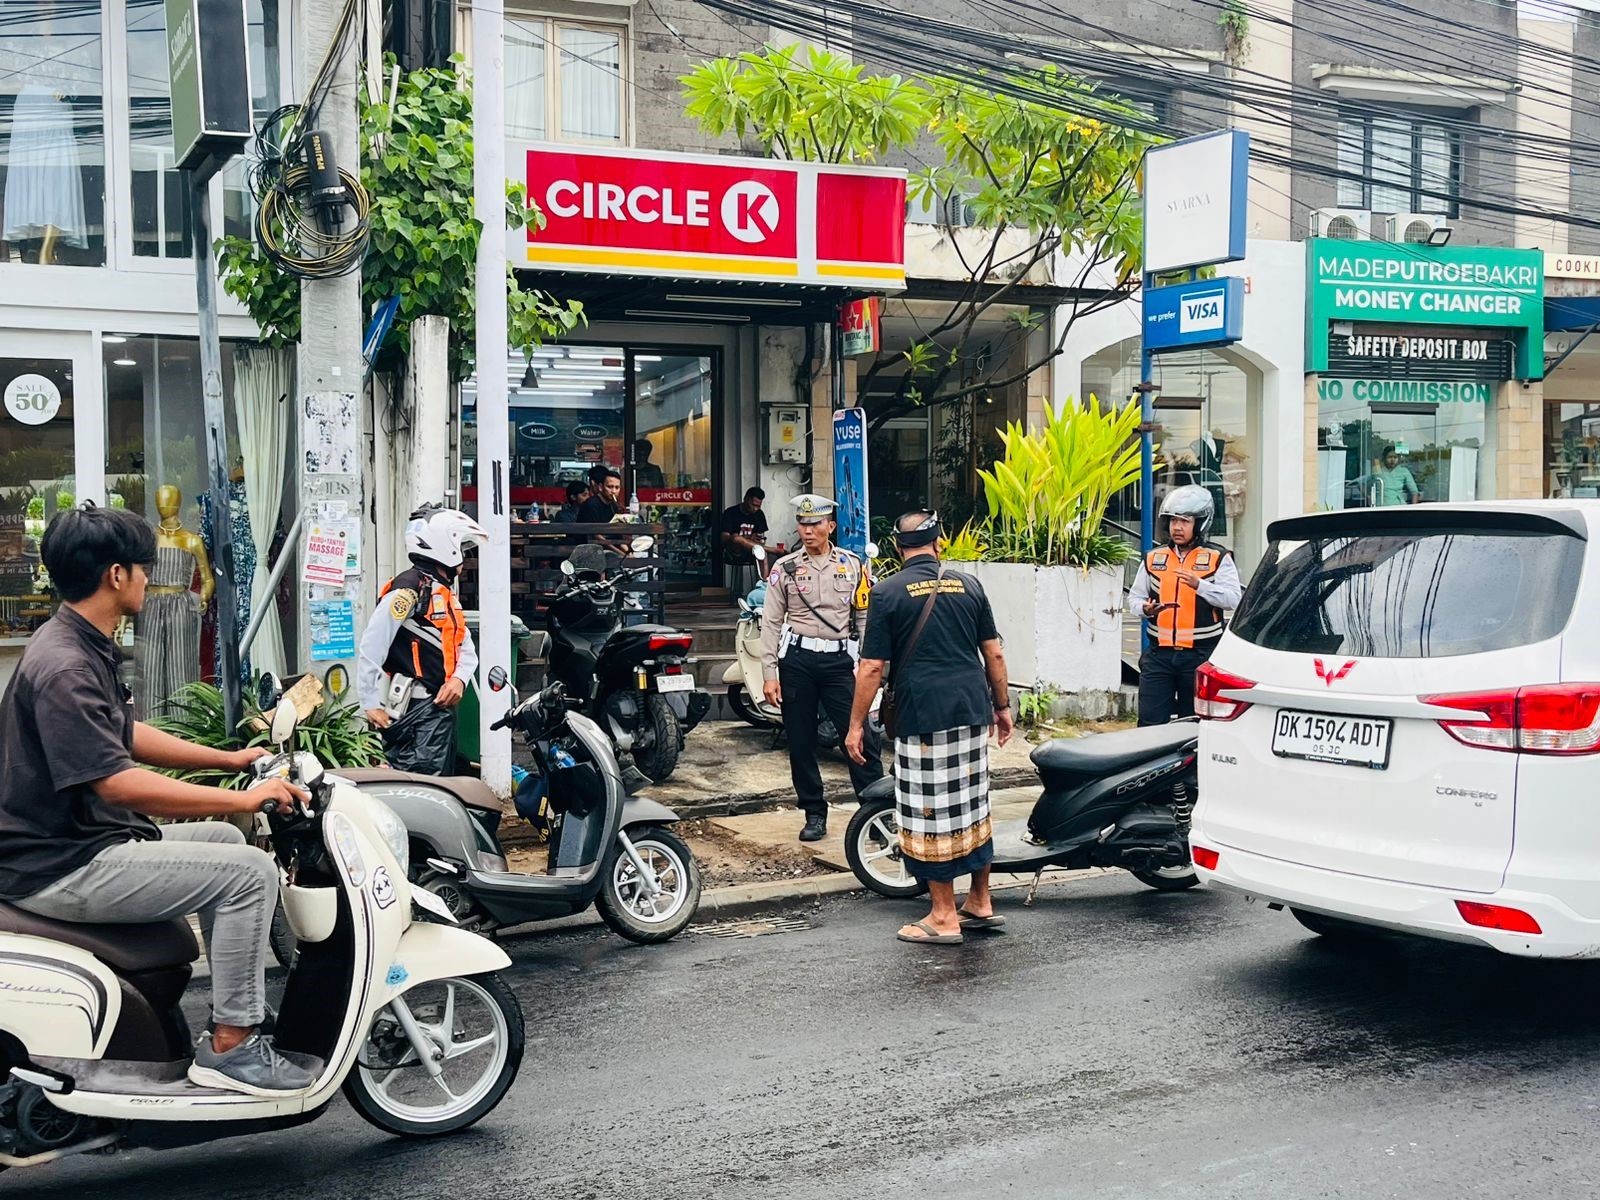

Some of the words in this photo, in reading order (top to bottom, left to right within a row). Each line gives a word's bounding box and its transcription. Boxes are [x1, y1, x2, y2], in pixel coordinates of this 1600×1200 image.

[546, 180, 709, 227] CIRCLE
[1167, 194, 1211, 212] SVARNA
[1158, 311, 1176, 322] prefer
[1187, 302, 1218, 320] VISA
[1336, 289, 1414, 310] MONEY
[1420, 292, 1521, 314] CHANGER
[1348, 335, 1397, 357] SAFETY
[1401, 337, 1457, 359] DEPOSIT
[1462, 340, 1488, 360] BOX
[1318, 380, 1343, 400] NO
[1353, 380, 1491, 403] COMMISSION
[683, 491, 693, 501] K
[308, 543, 345, 557] MASSAGE
[1279, 715, 1300, 738] DK
[1303, 717, 1347, 743] 1594
[1350, 722, 1385, 747] ADT
